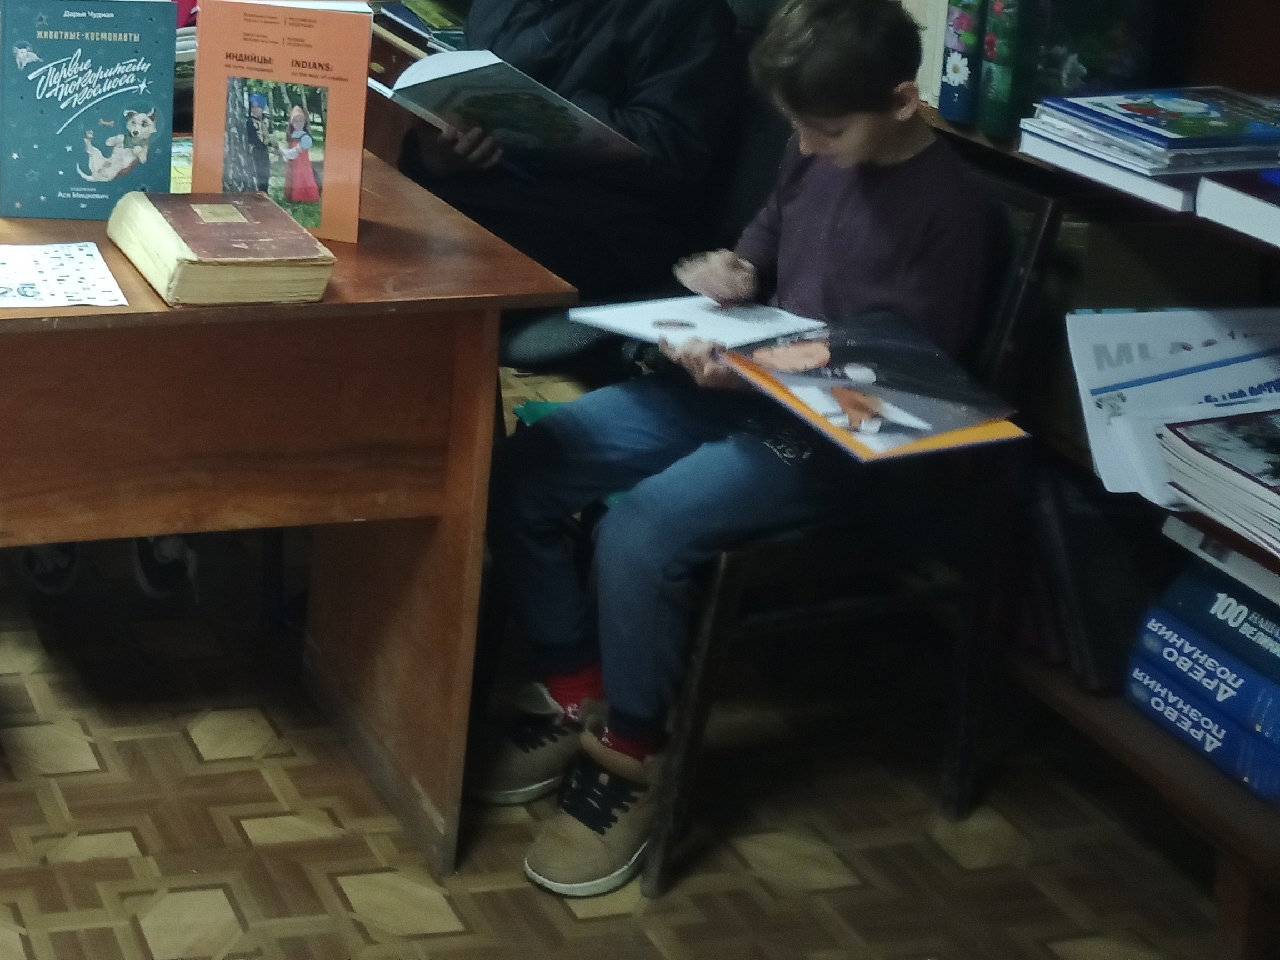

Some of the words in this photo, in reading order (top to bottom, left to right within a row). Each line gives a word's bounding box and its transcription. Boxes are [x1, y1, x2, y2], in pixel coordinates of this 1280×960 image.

[36, 30, 141, 43] ЖИВОТНЫЕ-КОСМОНАВТЫ
[63, 10, 87, 19] Дарья
[28, 48, 92, 100] Первые
[46, 56, 152, 102] покорители
[291, 59, 334, 73] INDIANS:
[60, 73, 137, 109] космоса
[1209, 592, 1249, 628] 100
[1146, 618, 1245, 689] ПОЗНАНИЯ
[1162, 647, 1237, 702] ДРЕВО
[1132, 667, 1227, 740] ПОЗНАНИЯ
[1150, 696, 1222, 753] ДРЕВО
